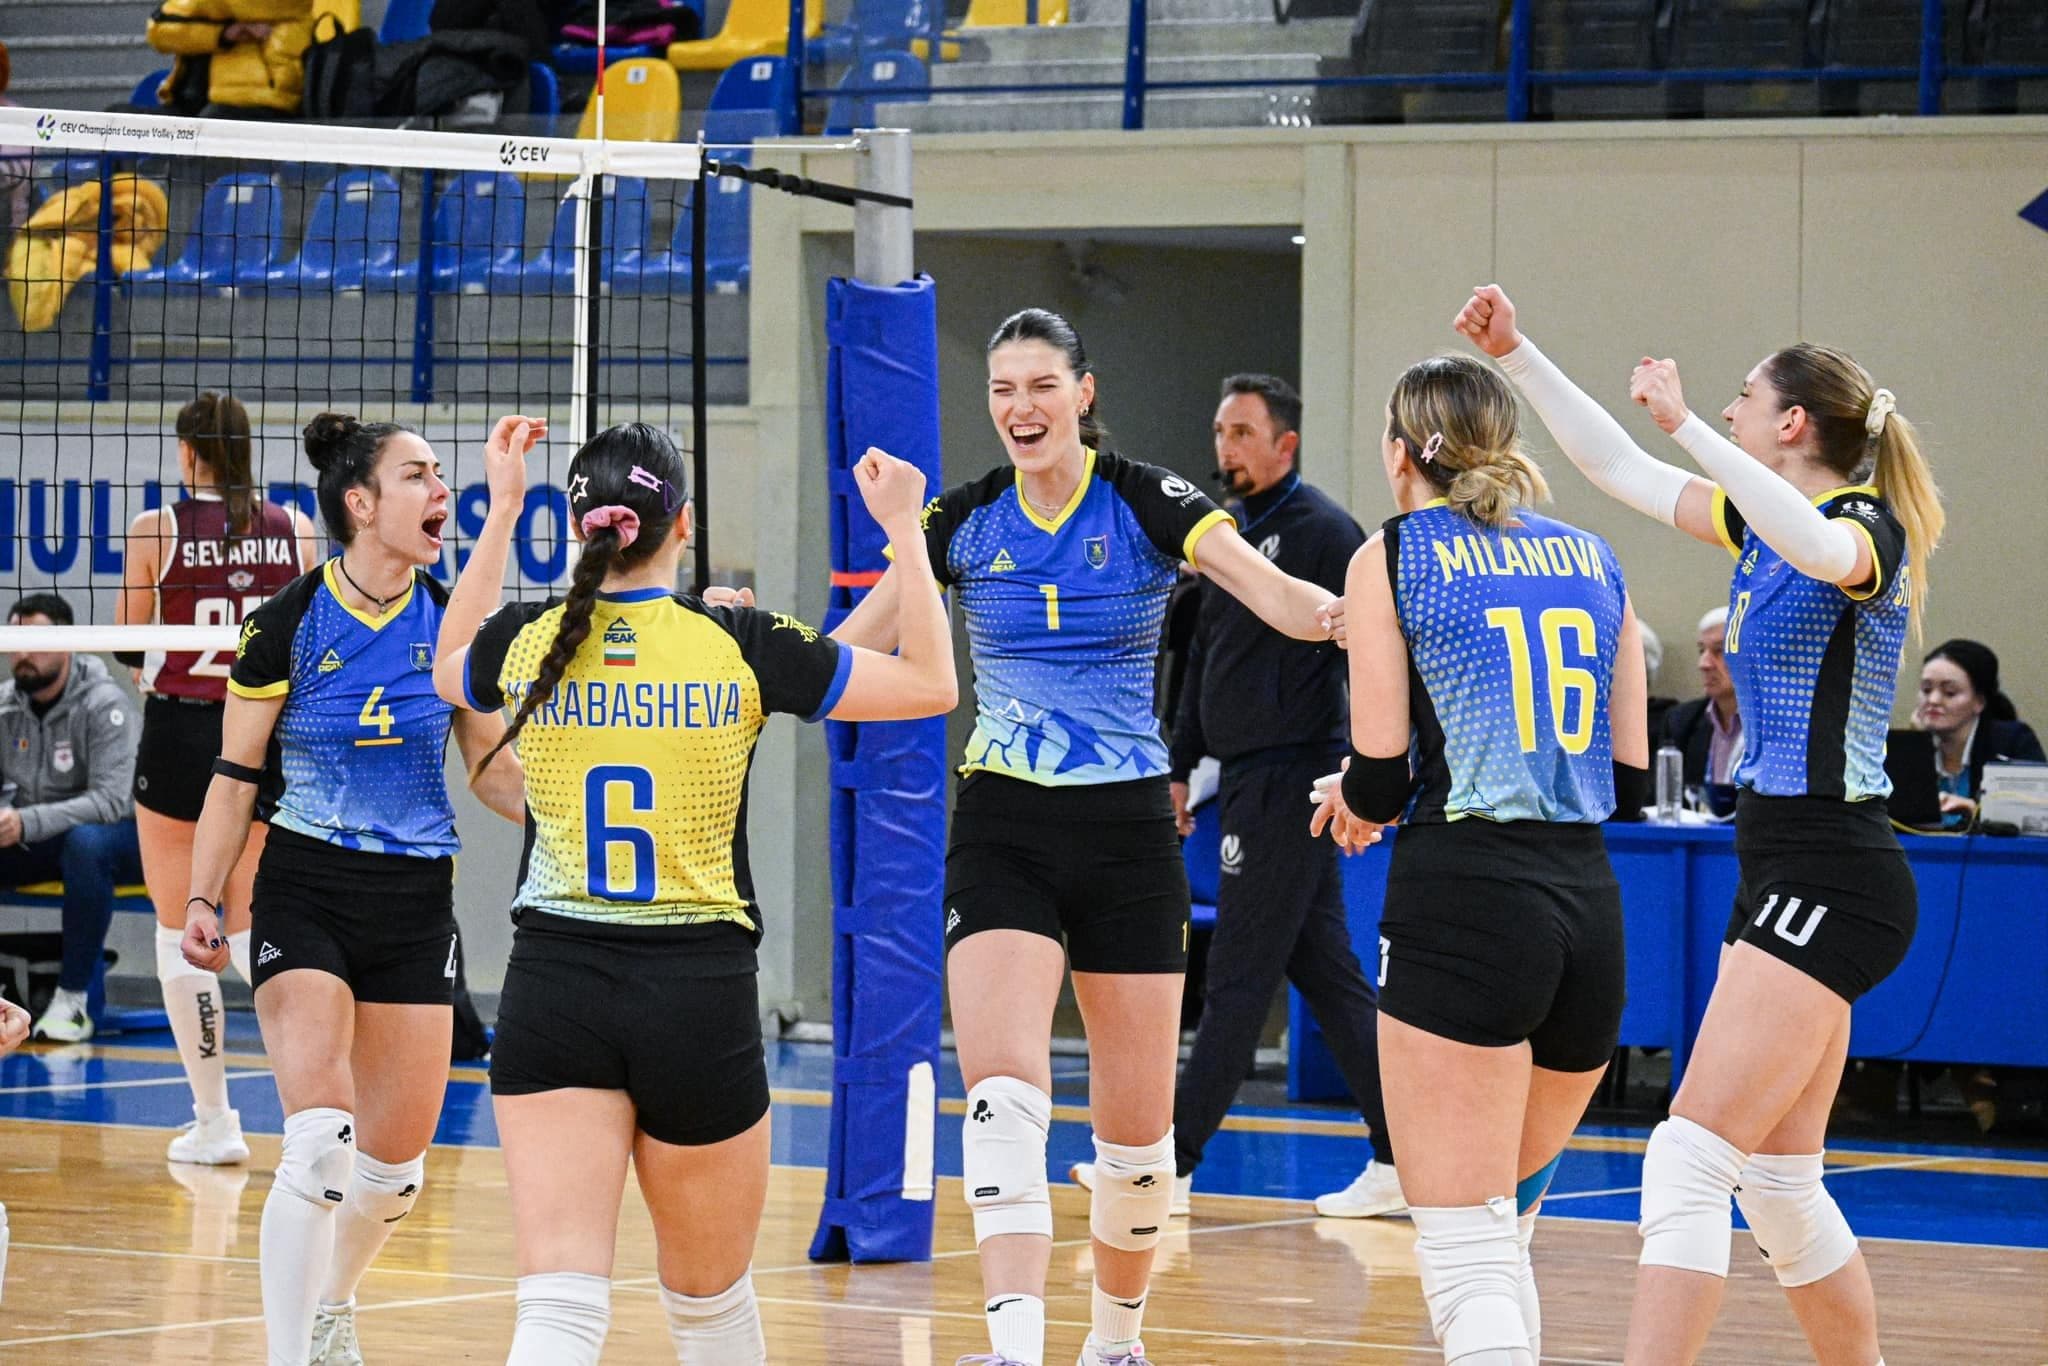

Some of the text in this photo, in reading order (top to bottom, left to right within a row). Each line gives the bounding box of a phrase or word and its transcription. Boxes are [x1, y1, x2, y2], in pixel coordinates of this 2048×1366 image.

[60, 122, 194, 141] CEV Champions League Volley 2025
[520, 146, 550, 161] CEV
[182, 538, 292, 568] SEVARIKA
[1432, 534, 1607, 587] MILANOVA
[1038, 584, 1060, 630] 1
[604, 632, 637, 644] PEAK
[1485, 606, 1598, 755] 16
[358, 686, 395, 736] 4
[585, 763, 657, 903] 6
[257, 949, 283, 967] PEAK
[197, 991, 219, 1060] Kempa
